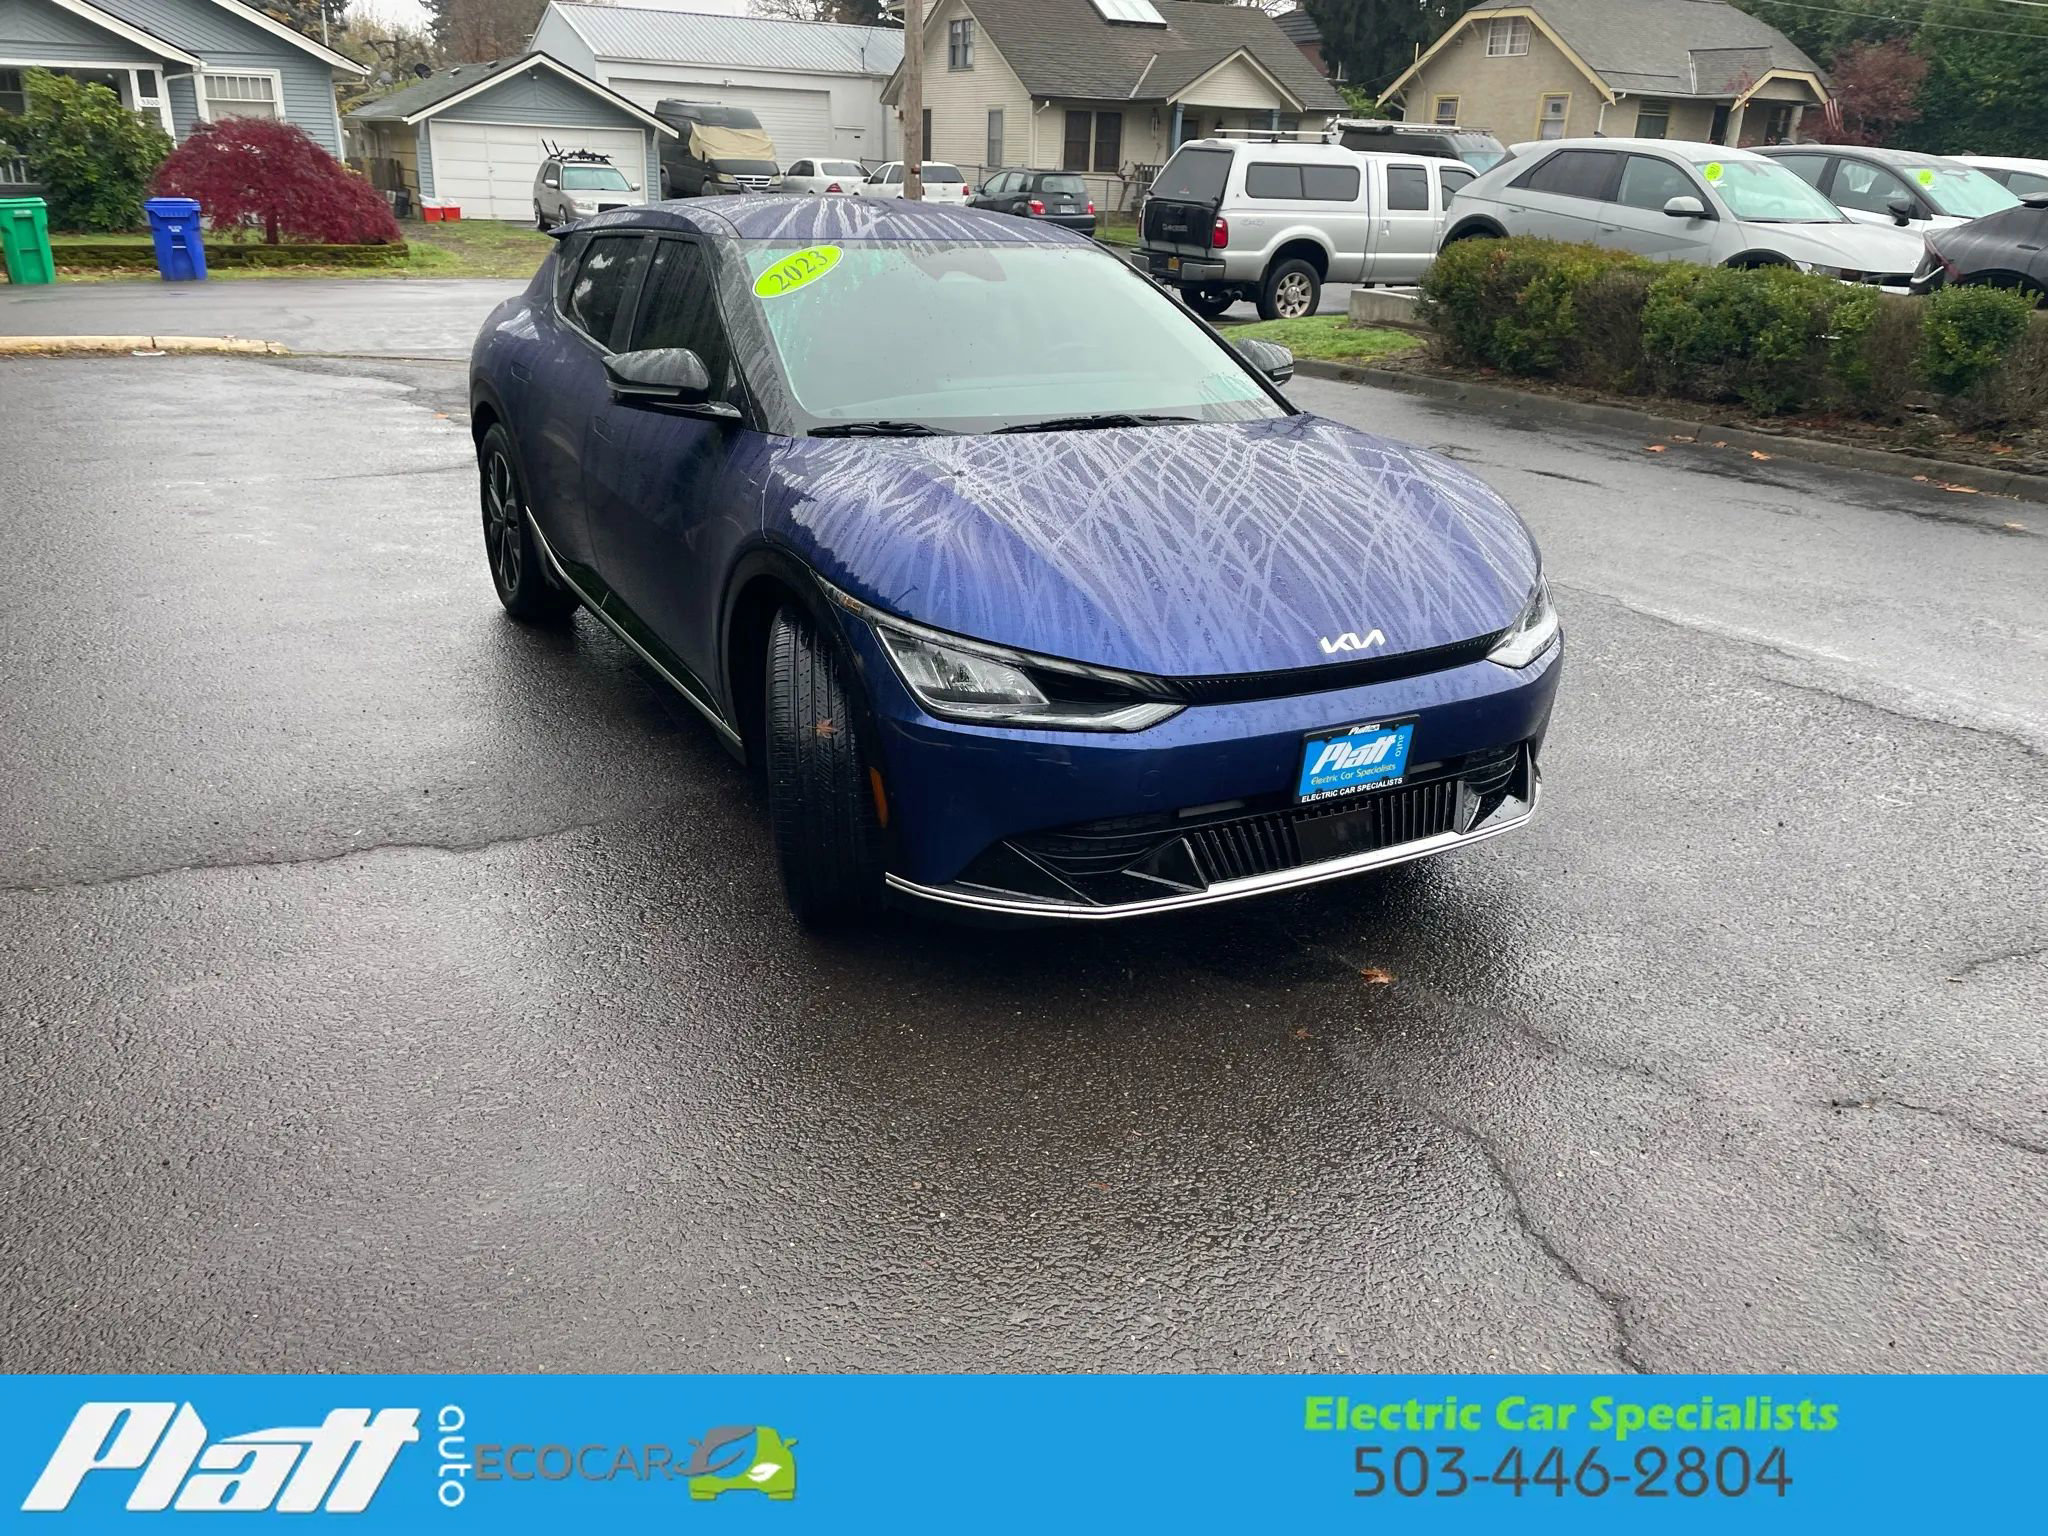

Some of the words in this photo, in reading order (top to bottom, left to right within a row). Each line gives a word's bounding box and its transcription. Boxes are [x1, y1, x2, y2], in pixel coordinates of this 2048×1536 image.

[769, 250, 828, 291] 2023
[1320, 629, 1386, 654] KIA
[1309, 734, 1398, 775] Platt
[1395, 734, 1404, 757] auto
[1311, 774, 1338, 786] Electric
[1341, 771, 1354, 780] Car
[1357, 763, 1396, 778] Specialists
[1301, 789, 1338, 803] ELECTRIC
[1340, 786, 1355, 796] CAR
[1357, 777, 1403, 792] SPECIALISTS
